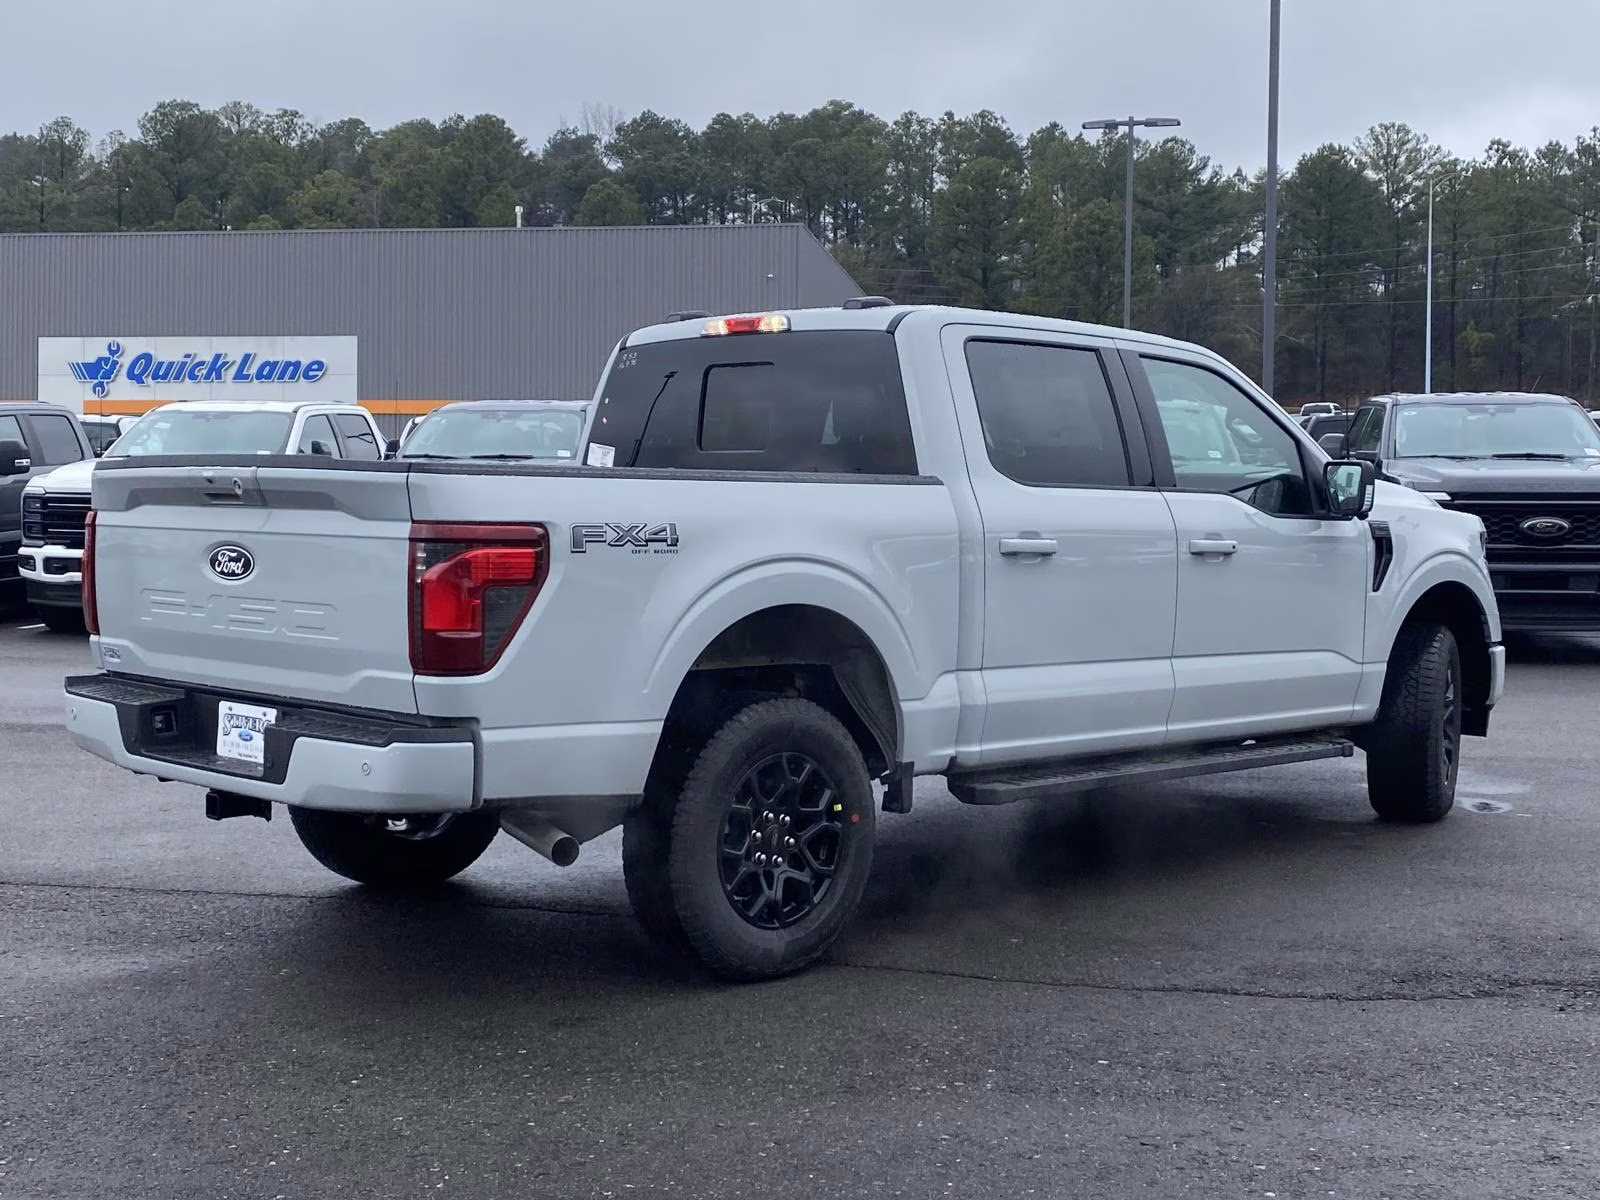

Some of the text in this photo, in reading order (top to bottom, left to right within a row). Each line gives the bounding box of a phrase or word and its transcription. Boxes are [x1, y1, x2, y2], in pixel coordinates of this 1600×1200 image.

[126, 352, 327, 385] Quick Lane
[569, 523, 679, 553] FX4
[214, 549, 246, 574] Ford
[140, 587, 339, 641] F-150
